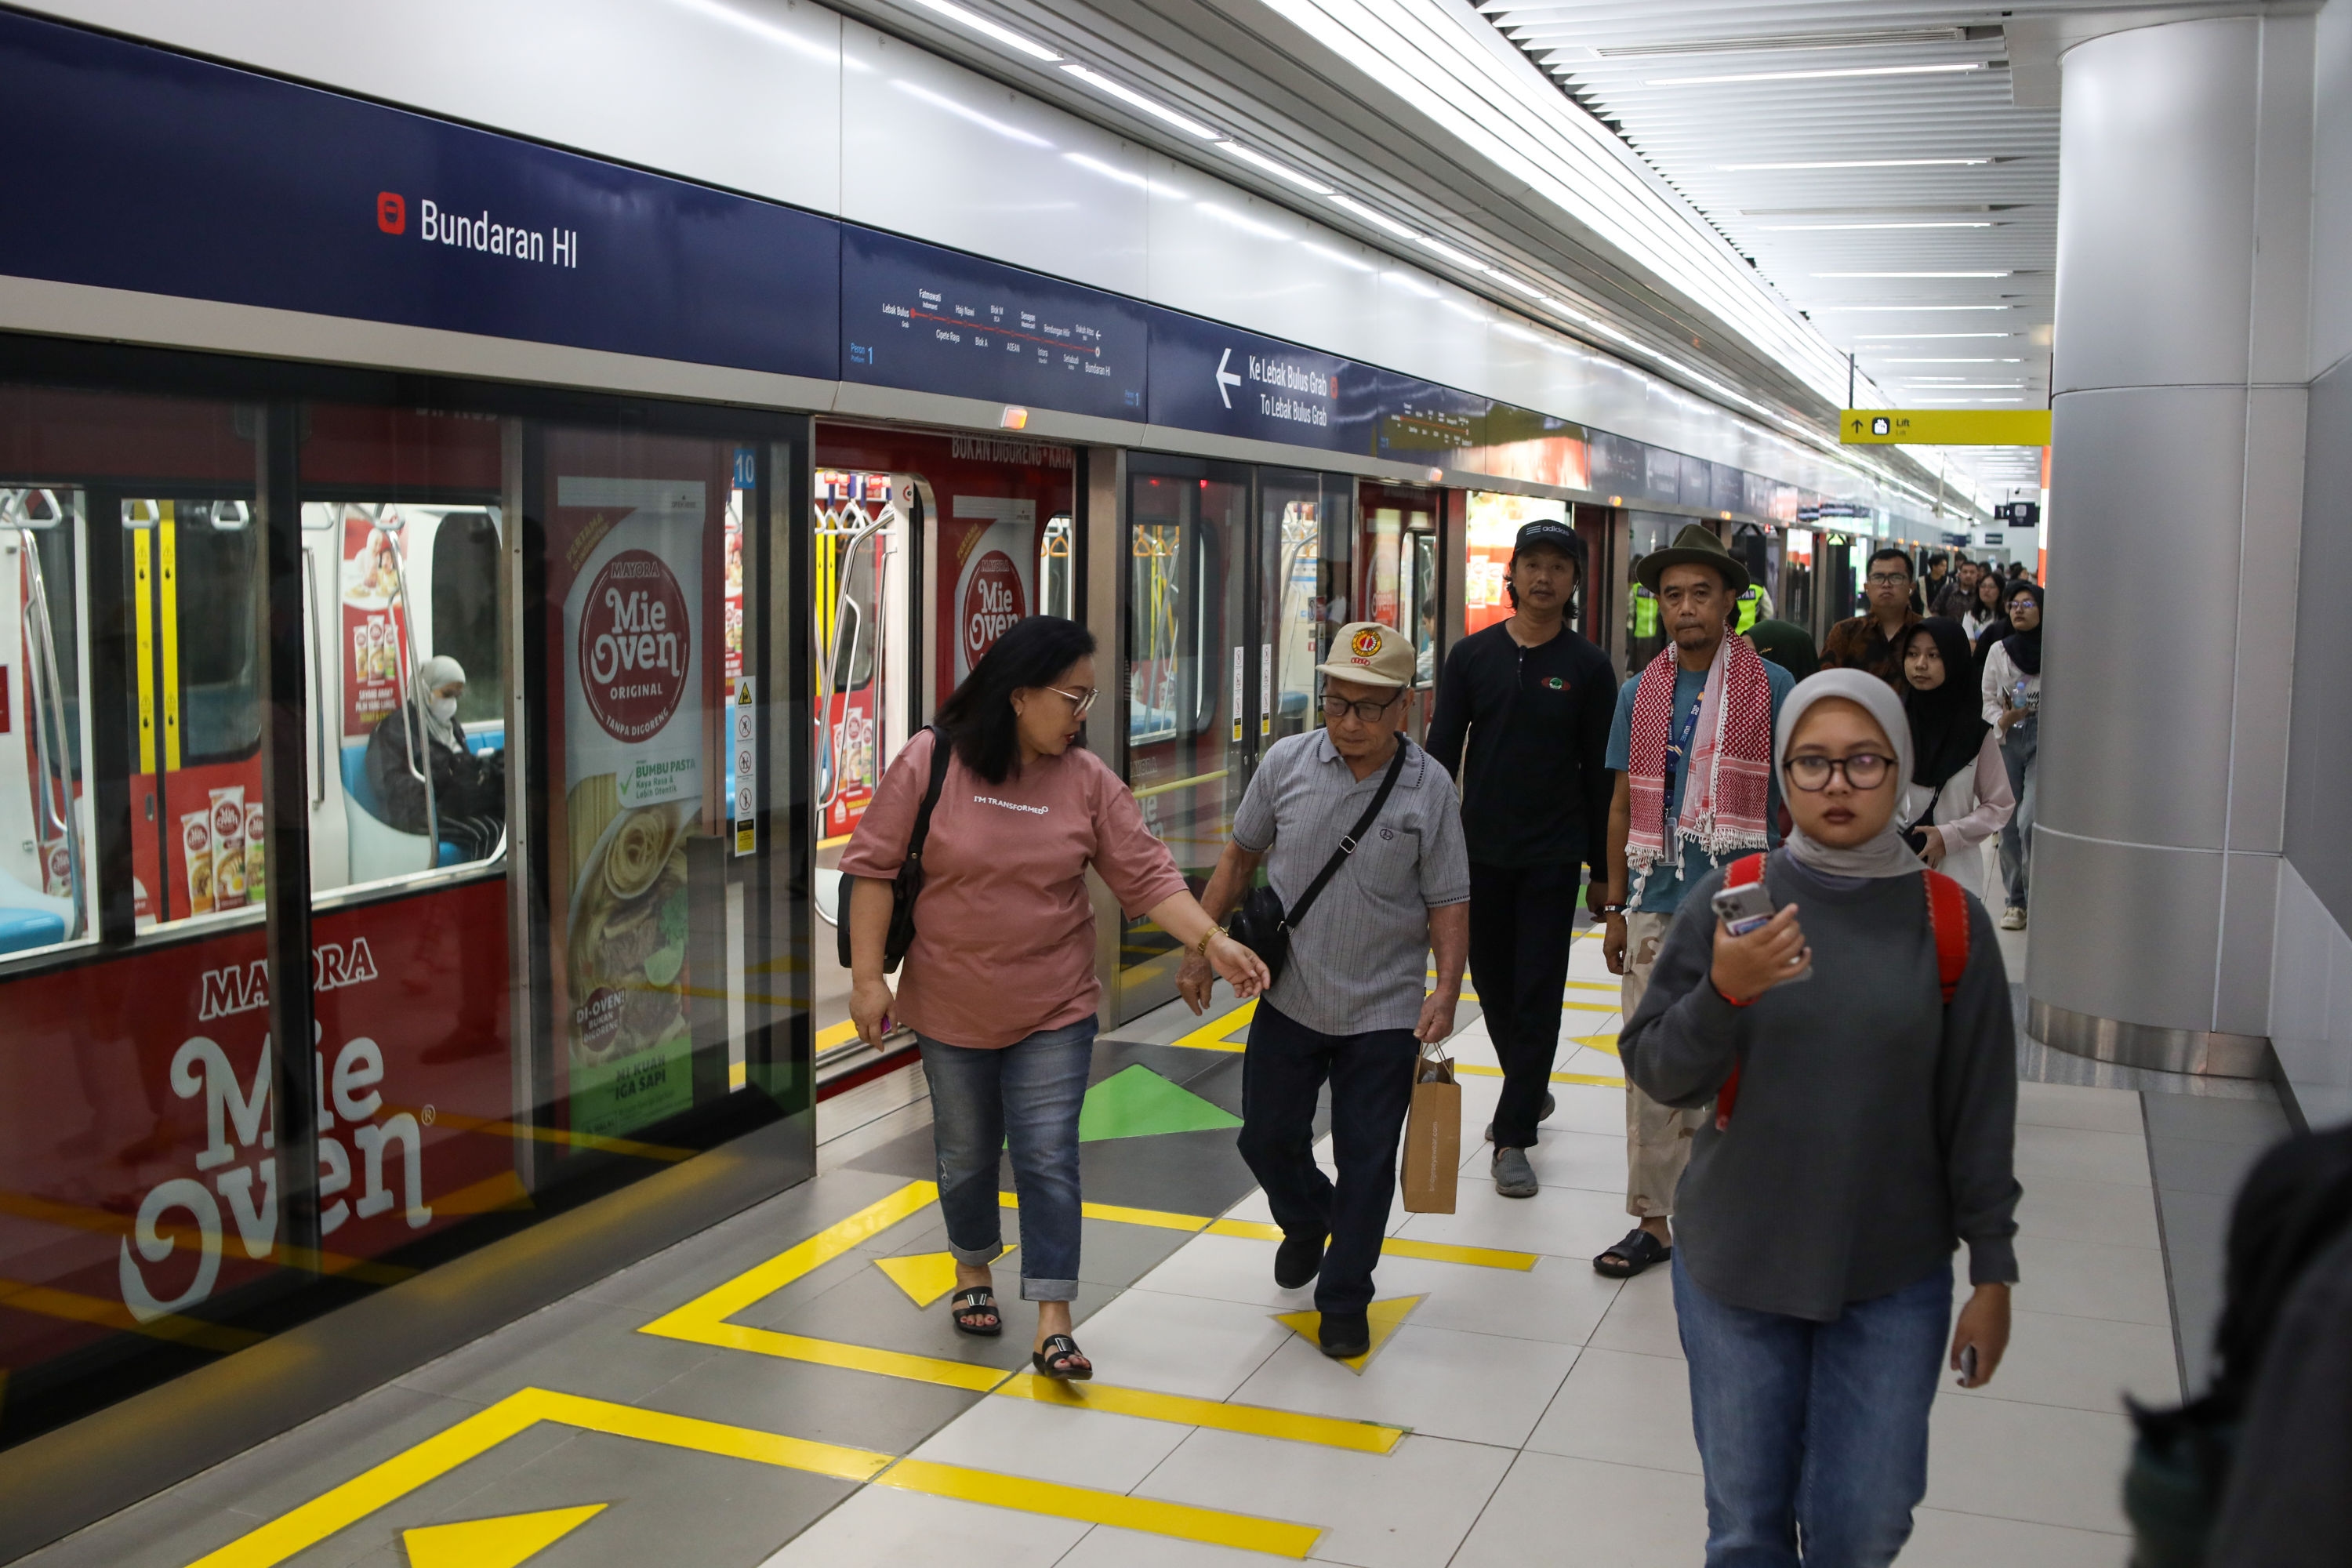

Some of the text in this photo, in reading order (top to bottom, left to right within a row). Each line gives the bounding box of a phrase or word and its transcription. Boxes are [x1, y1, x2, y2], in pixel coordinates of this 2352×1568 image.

[421, 198, 578, 269] Bundaran HI
[919, 289, 942, 302] Fatmawati
[882, 303, 909, 318] Lebak Bulus
[990, 305, 1004, 315] Blok M
[936, 328, 960, 343] Cipete Raya
[975, 336, 988, 347] Blok A
[868, 347, 873, 364] 1
[1007, 342, 1020, 352] ASEAN
[1085, 361, 1111, 376] Bundaran HI
[1249, 355, 1327, 396] Ke Lebak Bulus Grab
[1261, 394, 1327, 426] To Lebak Bulus Grab
[1896, 418, 1910, 426] Lift
[952, 436, 990, 461] BUKAN
[1049, 447, 1073, 469] KAYA
[735, 453, 754, 484] 10
[1542, 525, 1570, 537] adidas
[611, 561, 660, 579] MAYORA
[981, 559, 1010, 572] MAYORA
[979, 579, 1013, 614] Mie
[605, 587, 666, 633] Mie
[969, 612, 1018, 651] Oven
[591, 632, 681, 684] Oven
[610, 682, 662, 700] ORIGINAL
[606, 706, 670, 736] TANPA DIGORENG
[636, 758, 696, 779] BUMBU PASTA
[654, 785, 677, 796] Otentik
[974, 795, 986, 804] I'M
[199, 937, 378, 1021] MARA
[576, 989, 626, 1024] DI-OVEN!
[589, 1011, 614, 1029] BUKAN
[583, 1021, 619, 1043] DIGORENG
[633, 1054, 666, 1076] KUAH
[615, 1069, 666, 1101] IGA SAPI
